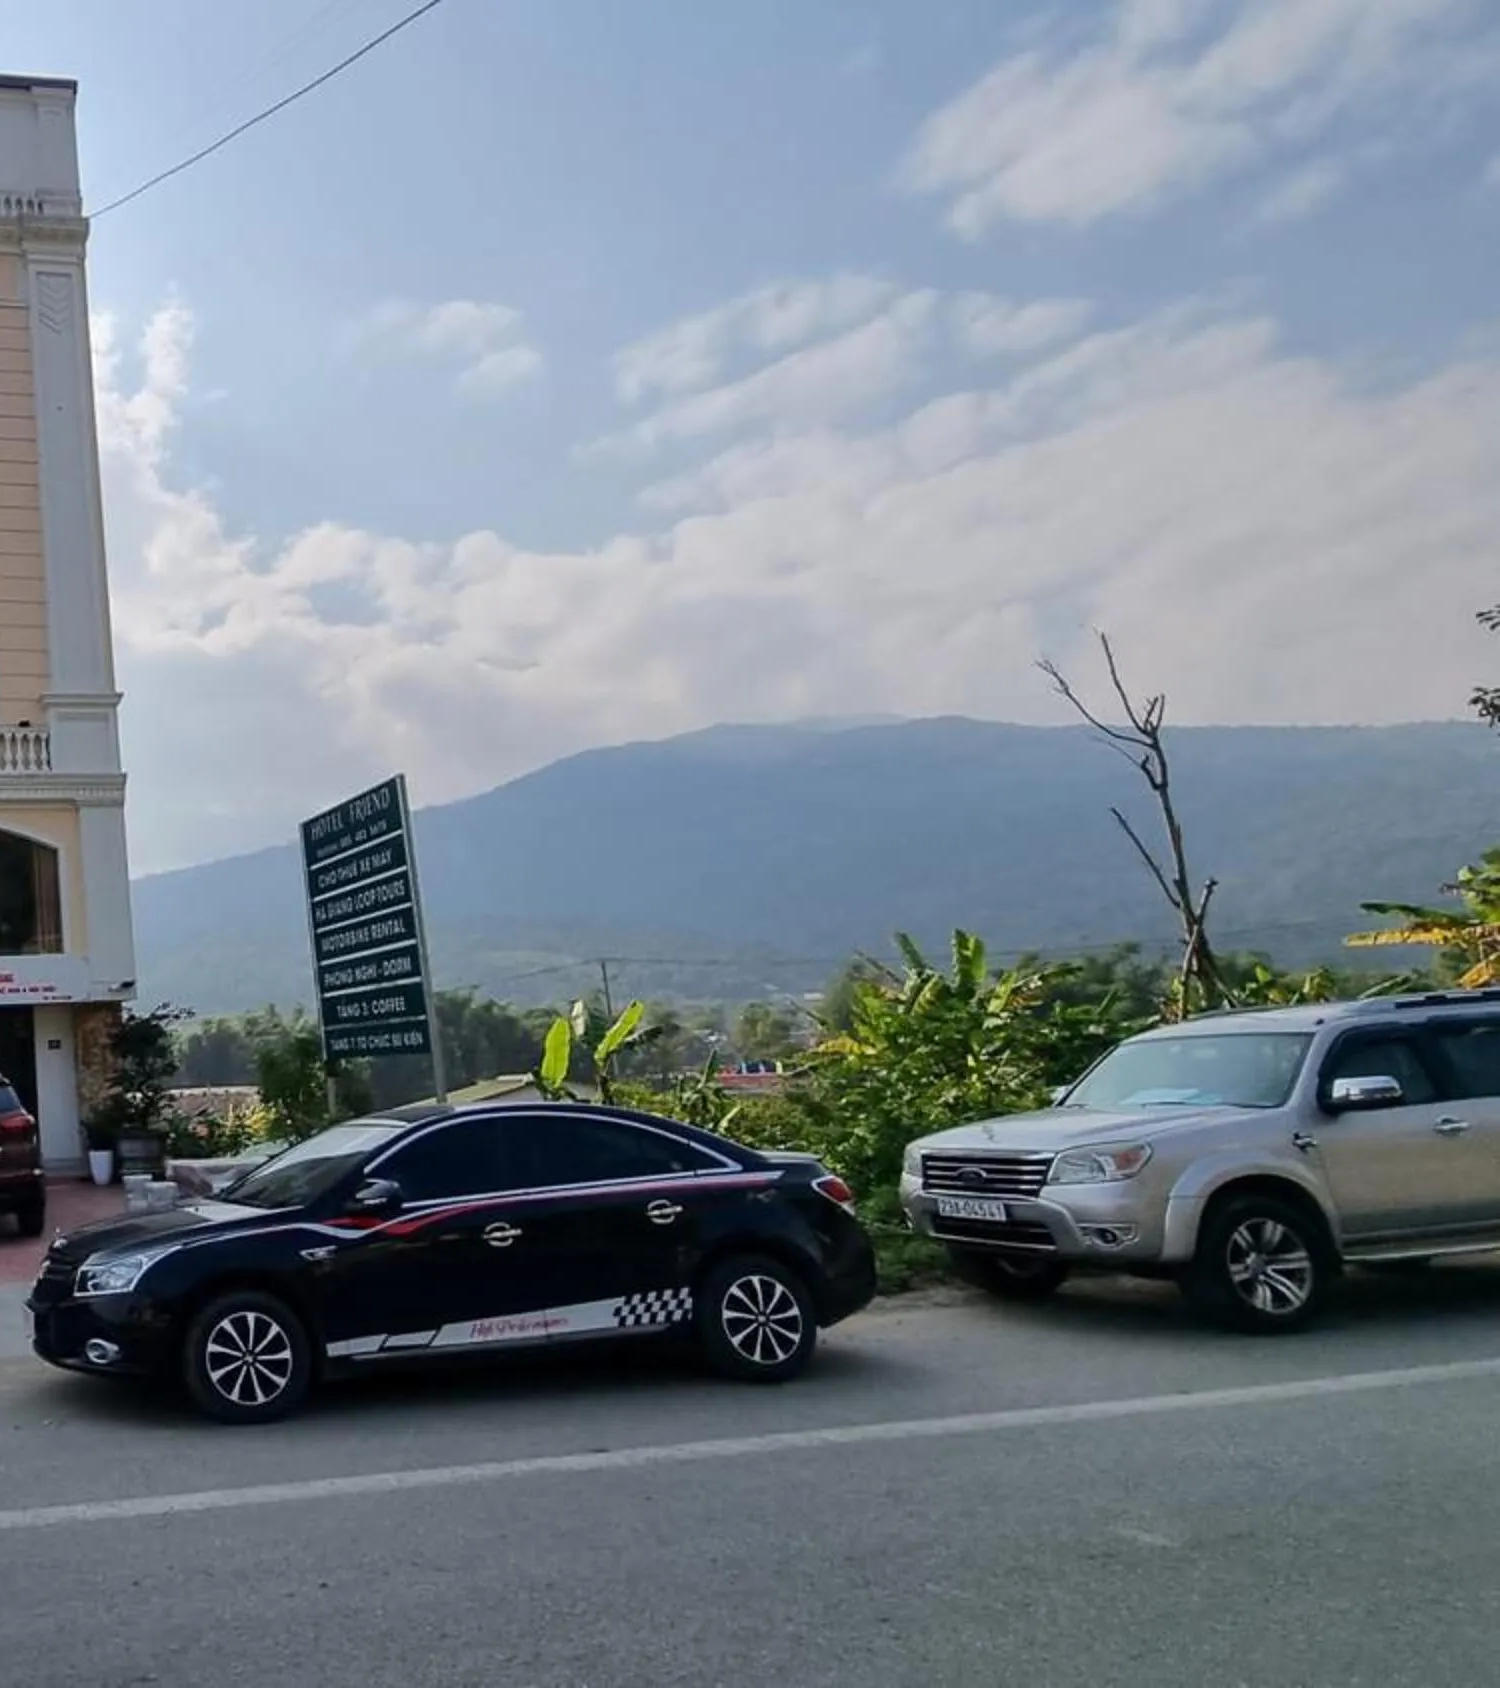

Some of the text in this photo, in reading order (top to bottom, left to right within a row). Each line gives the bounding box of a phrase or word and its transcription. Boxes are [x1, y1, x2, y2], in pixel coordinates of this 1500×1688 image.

[311, 787, 390, 841] HOTEL FRIEND
[376, 880, 405, 902] TOURS
[321, 917, 406, 953] MOTORBIKE RENTAL
[384, 956, 412, 977] DORM
[371, 996, 406, 1014] COFFEE
